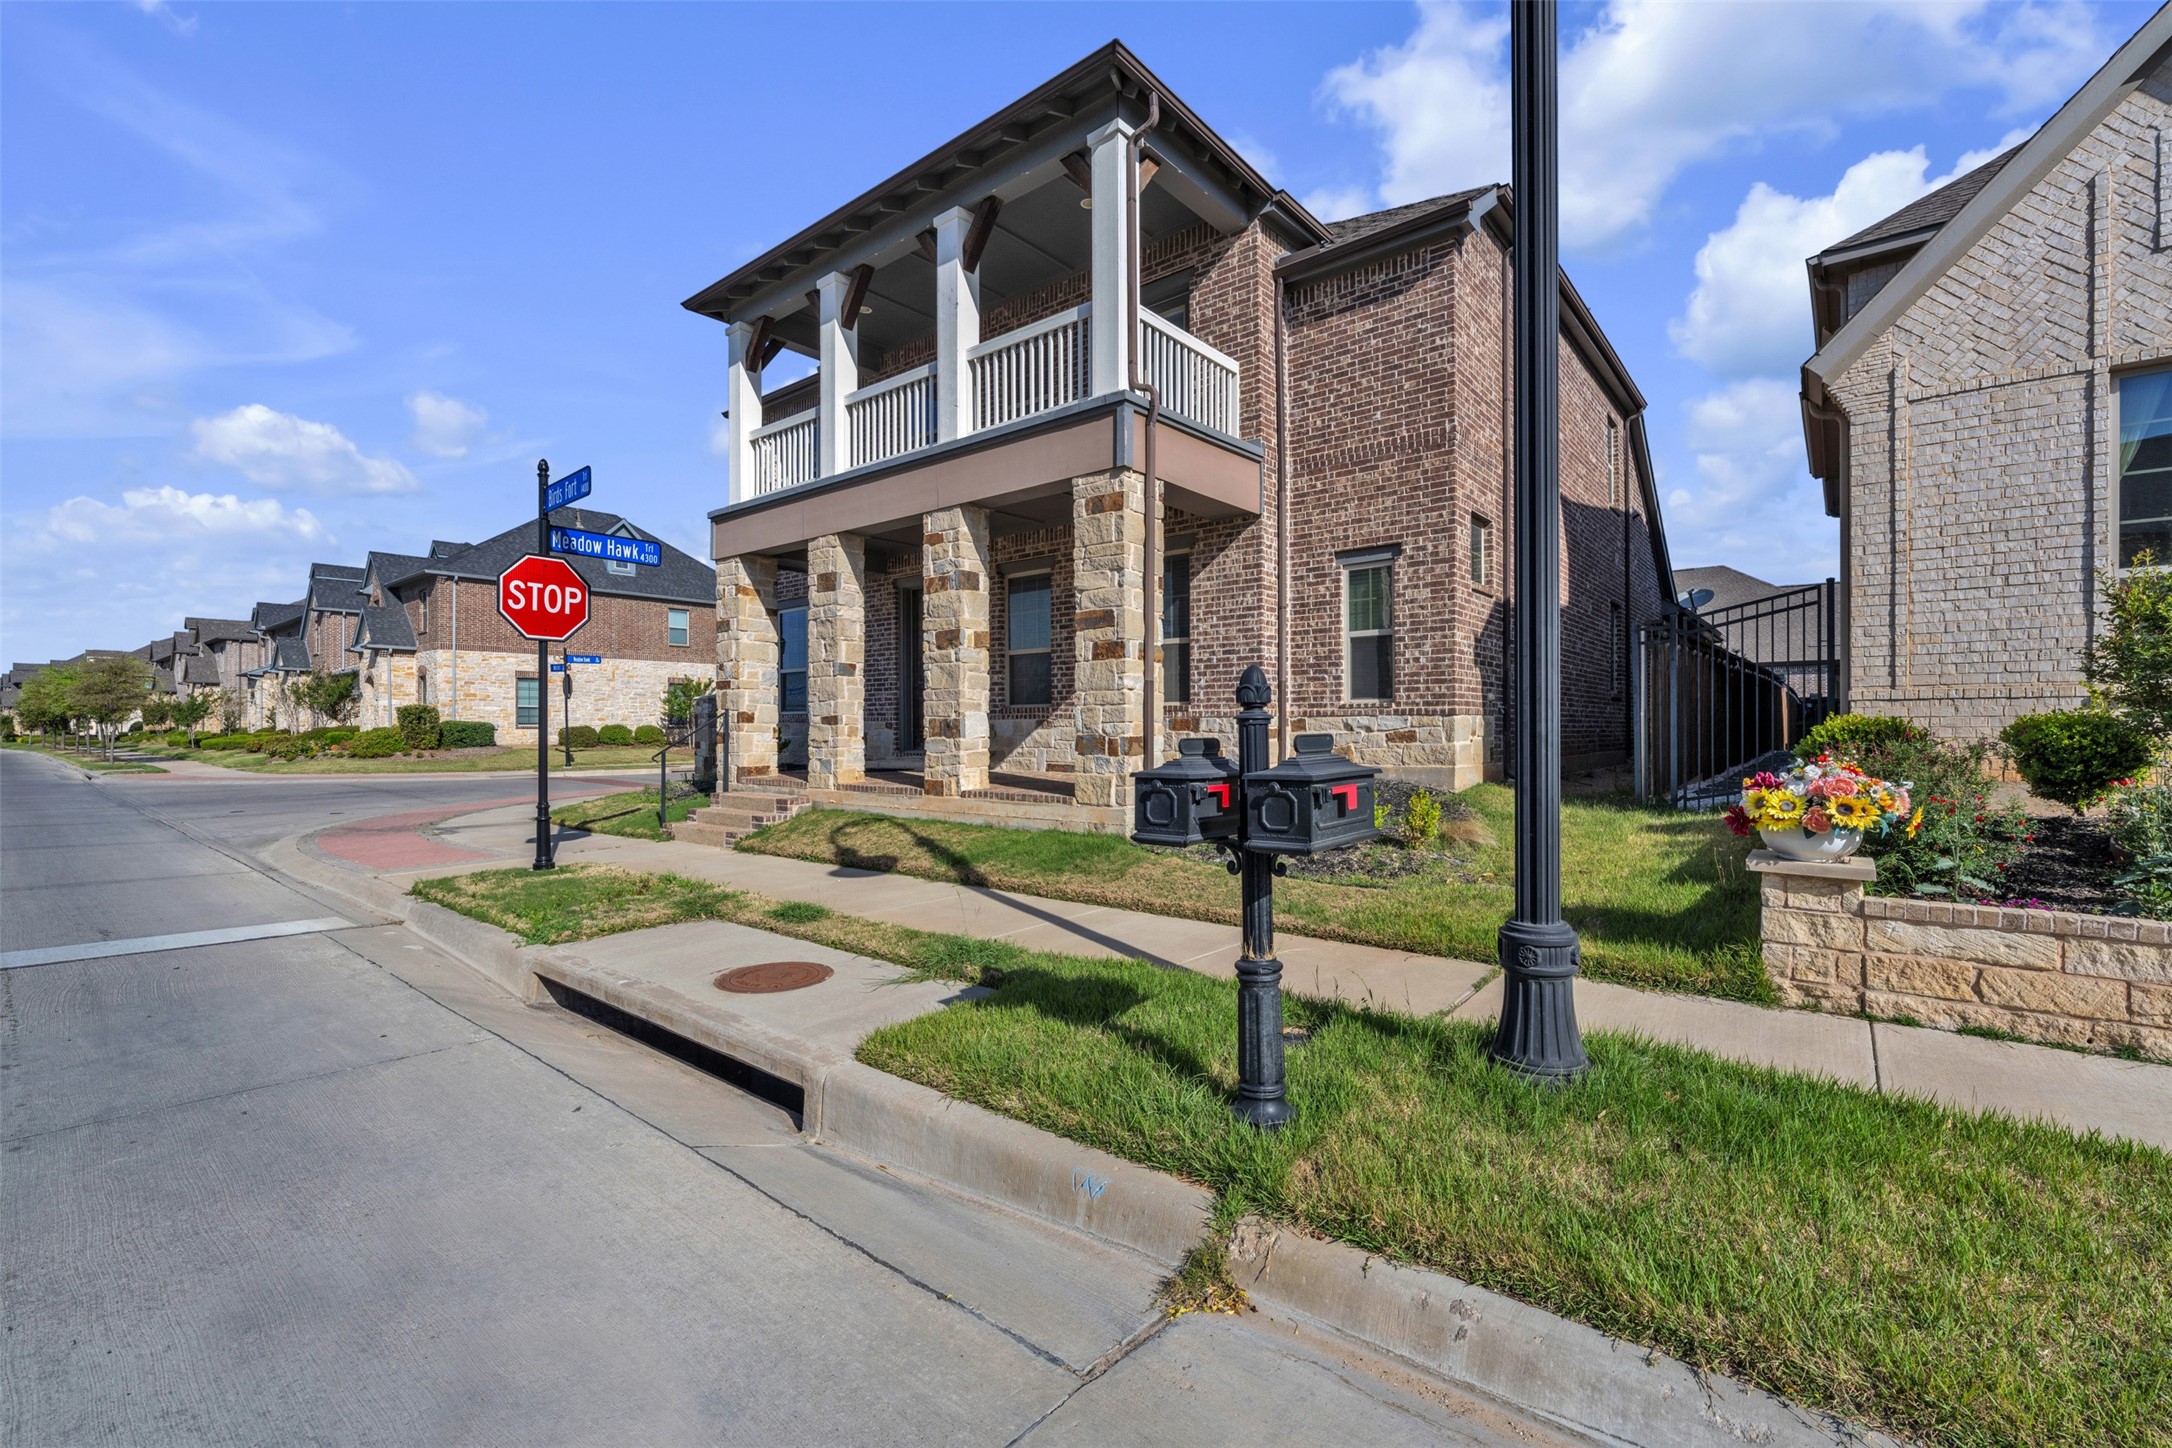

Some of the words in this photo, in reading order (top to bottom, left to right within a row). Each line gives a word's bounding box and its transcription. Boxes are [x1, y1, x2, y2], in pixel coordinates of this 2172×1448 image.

[548, 486, 562, 507] Birds
[564, 478, 577, 500] Fort
[552, 531, 602, 554] Meadow
[607, 539, 639, 560] Hawk
[640, 554, 658, 564] 4300
[645, 543, 654, 553] Trl
[507, 579, 582, 615] STOP
